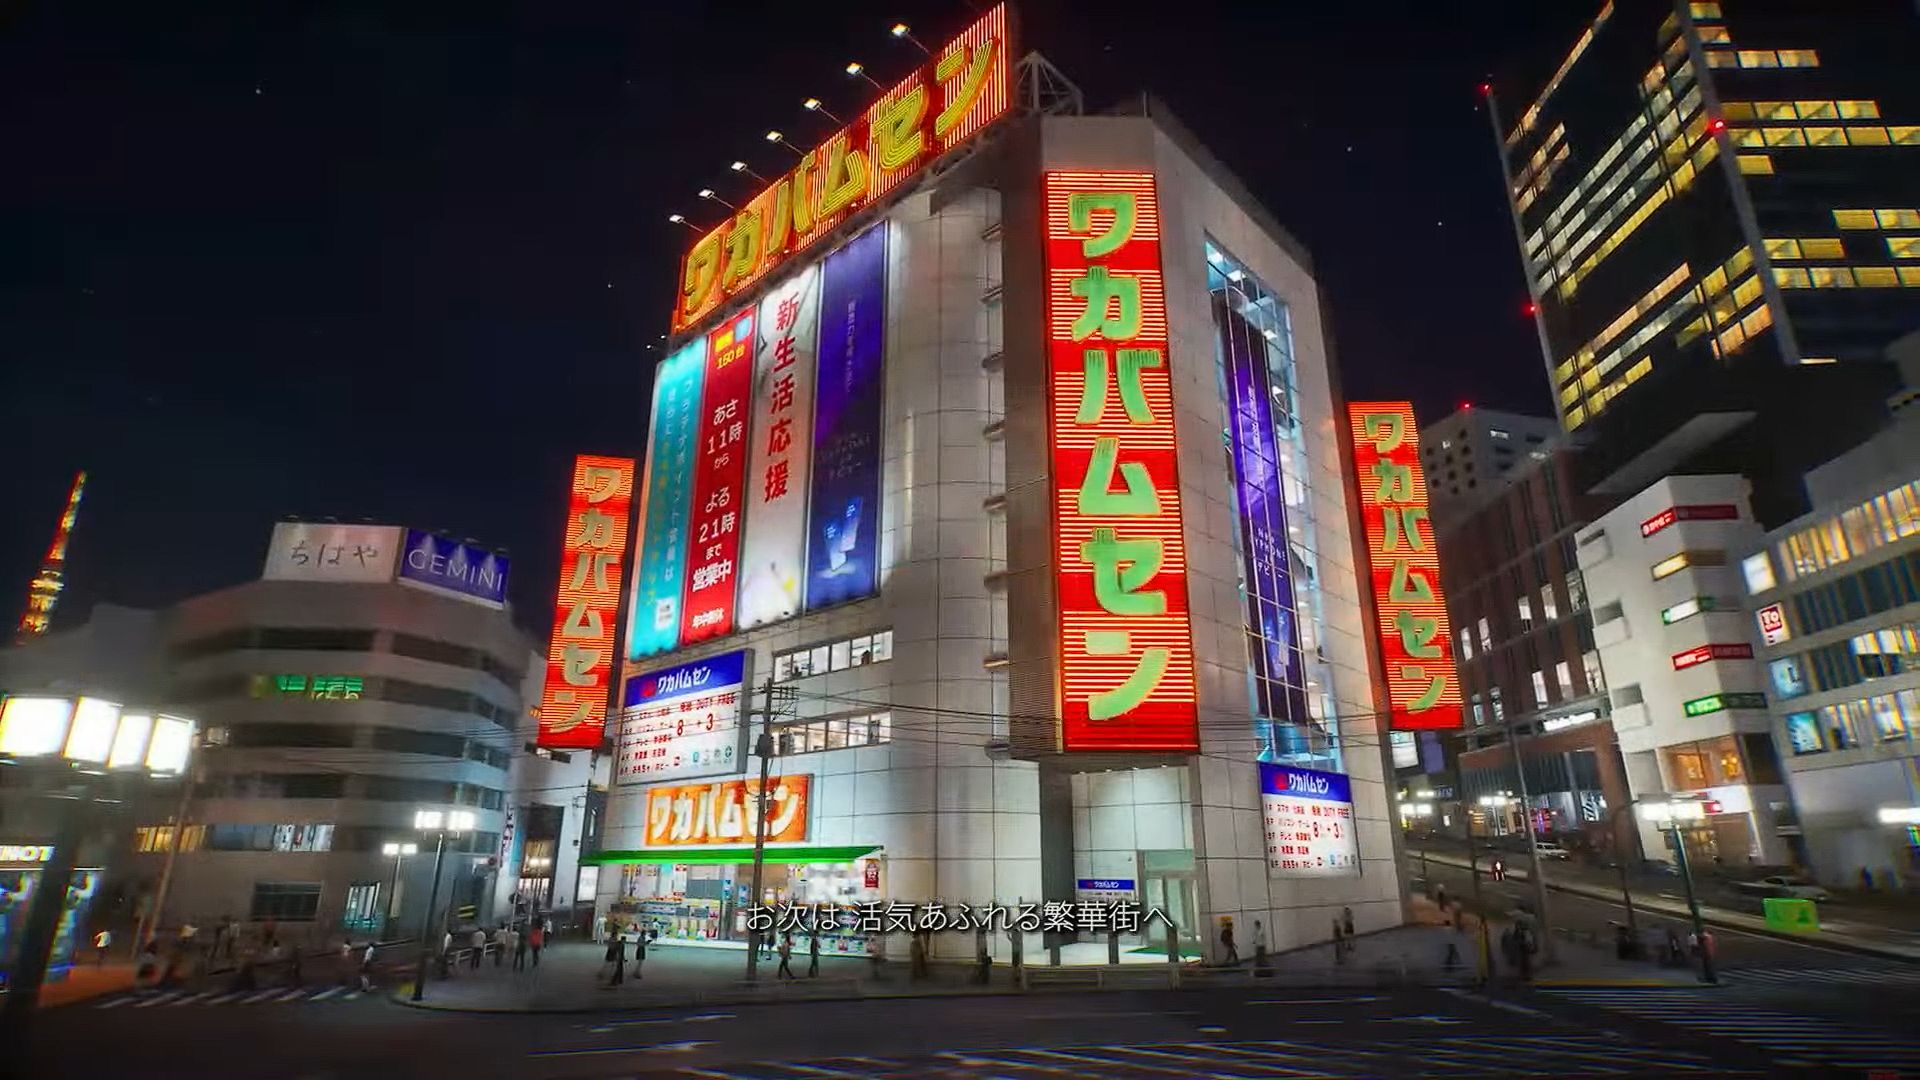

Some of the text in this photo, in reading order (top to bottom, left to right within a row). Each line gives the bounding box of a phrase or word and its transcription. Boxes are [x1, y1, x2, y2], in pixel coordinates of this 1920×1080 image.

[684, 38, 995, 318] ワカバムセン
[713, 398, 738, 425] あさ
[765, 292, 799, 502] 新生活応援
[707, 421, 742, 455] 11時
[1067, 190, 1171, 721] ワカバムセン
[705, 486, 730, 513] よる
[699, 511, 735, 543] 21時
[291, 539, 378, 569] ちはや
[407, 548, 504, 592] GEMINI
[1365, 413, 1448, 715] ワカバムセン
[692, 558, 732, 593] 営業中
[549, 466, 623, 734] ワカバムセン
[658, 666, 711, 694] ワカバムセン
[1288, 772, 1329, 794] ワカバムセン
[649, 783, 800, 841] ワカバムセン
